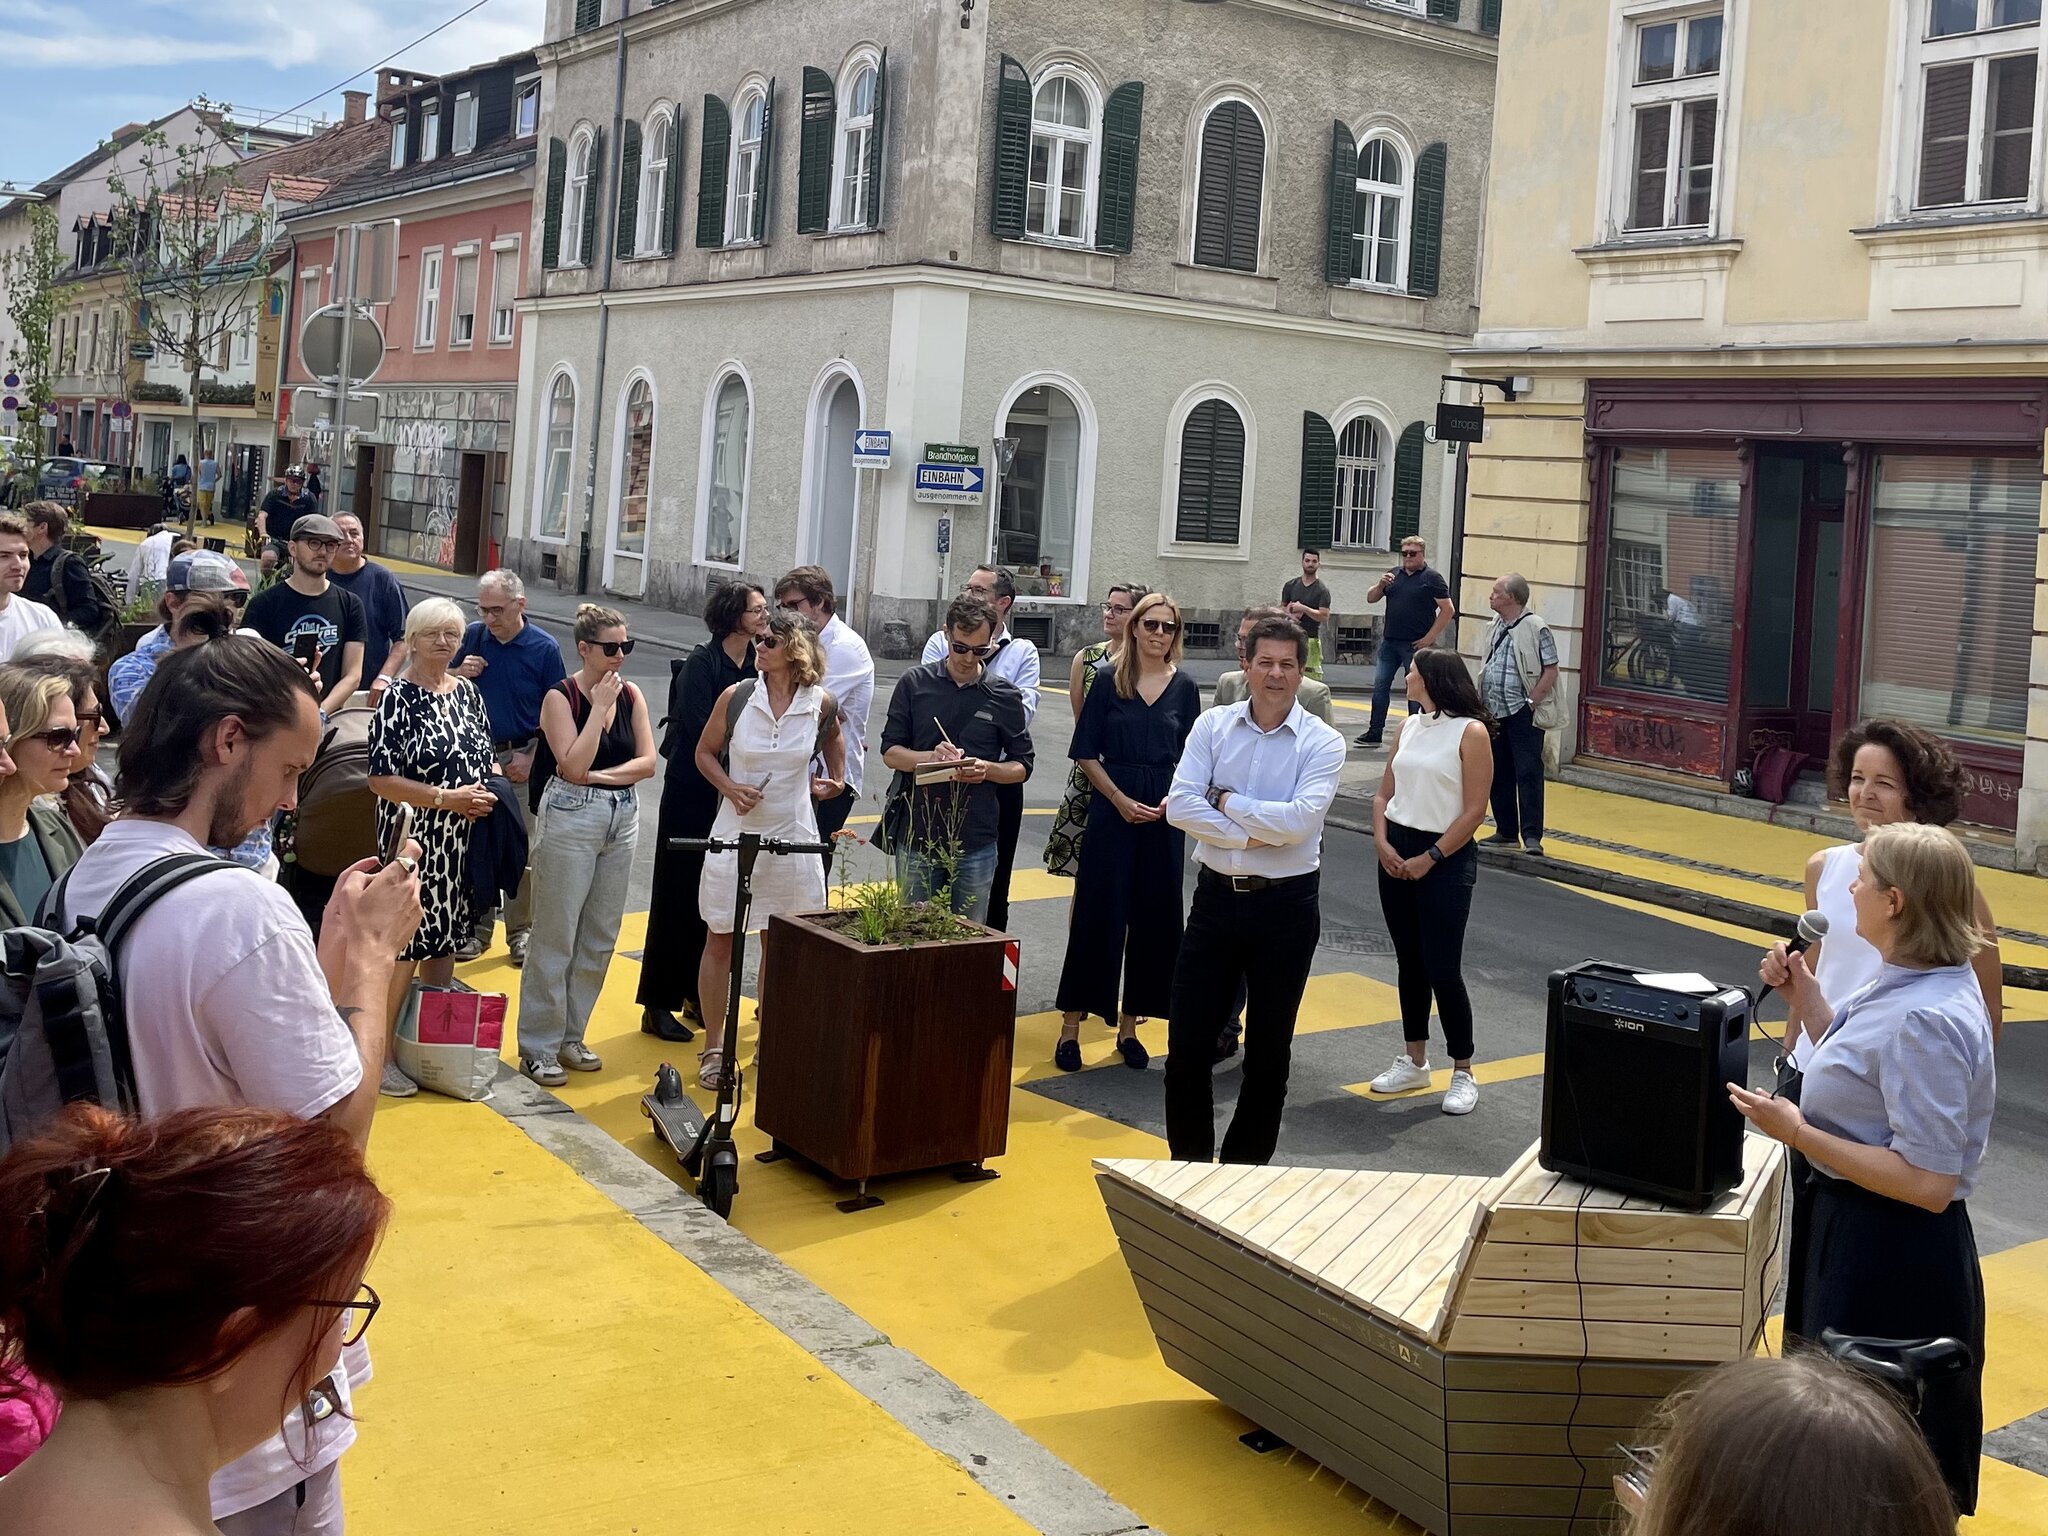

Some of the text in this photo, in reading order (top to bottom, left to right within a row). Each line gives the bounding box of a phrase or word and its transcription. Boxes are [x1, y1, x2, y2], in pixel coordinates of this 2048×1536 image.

[1450, 417, 1479, 432] drops
[865, 437, 888, 448] EINBAHN
[927, 451, 977, 463] Brandhofgasse
[922, 471, 964, 484] EINBAHN
[917, 492, 967, 500] ausgenommen
